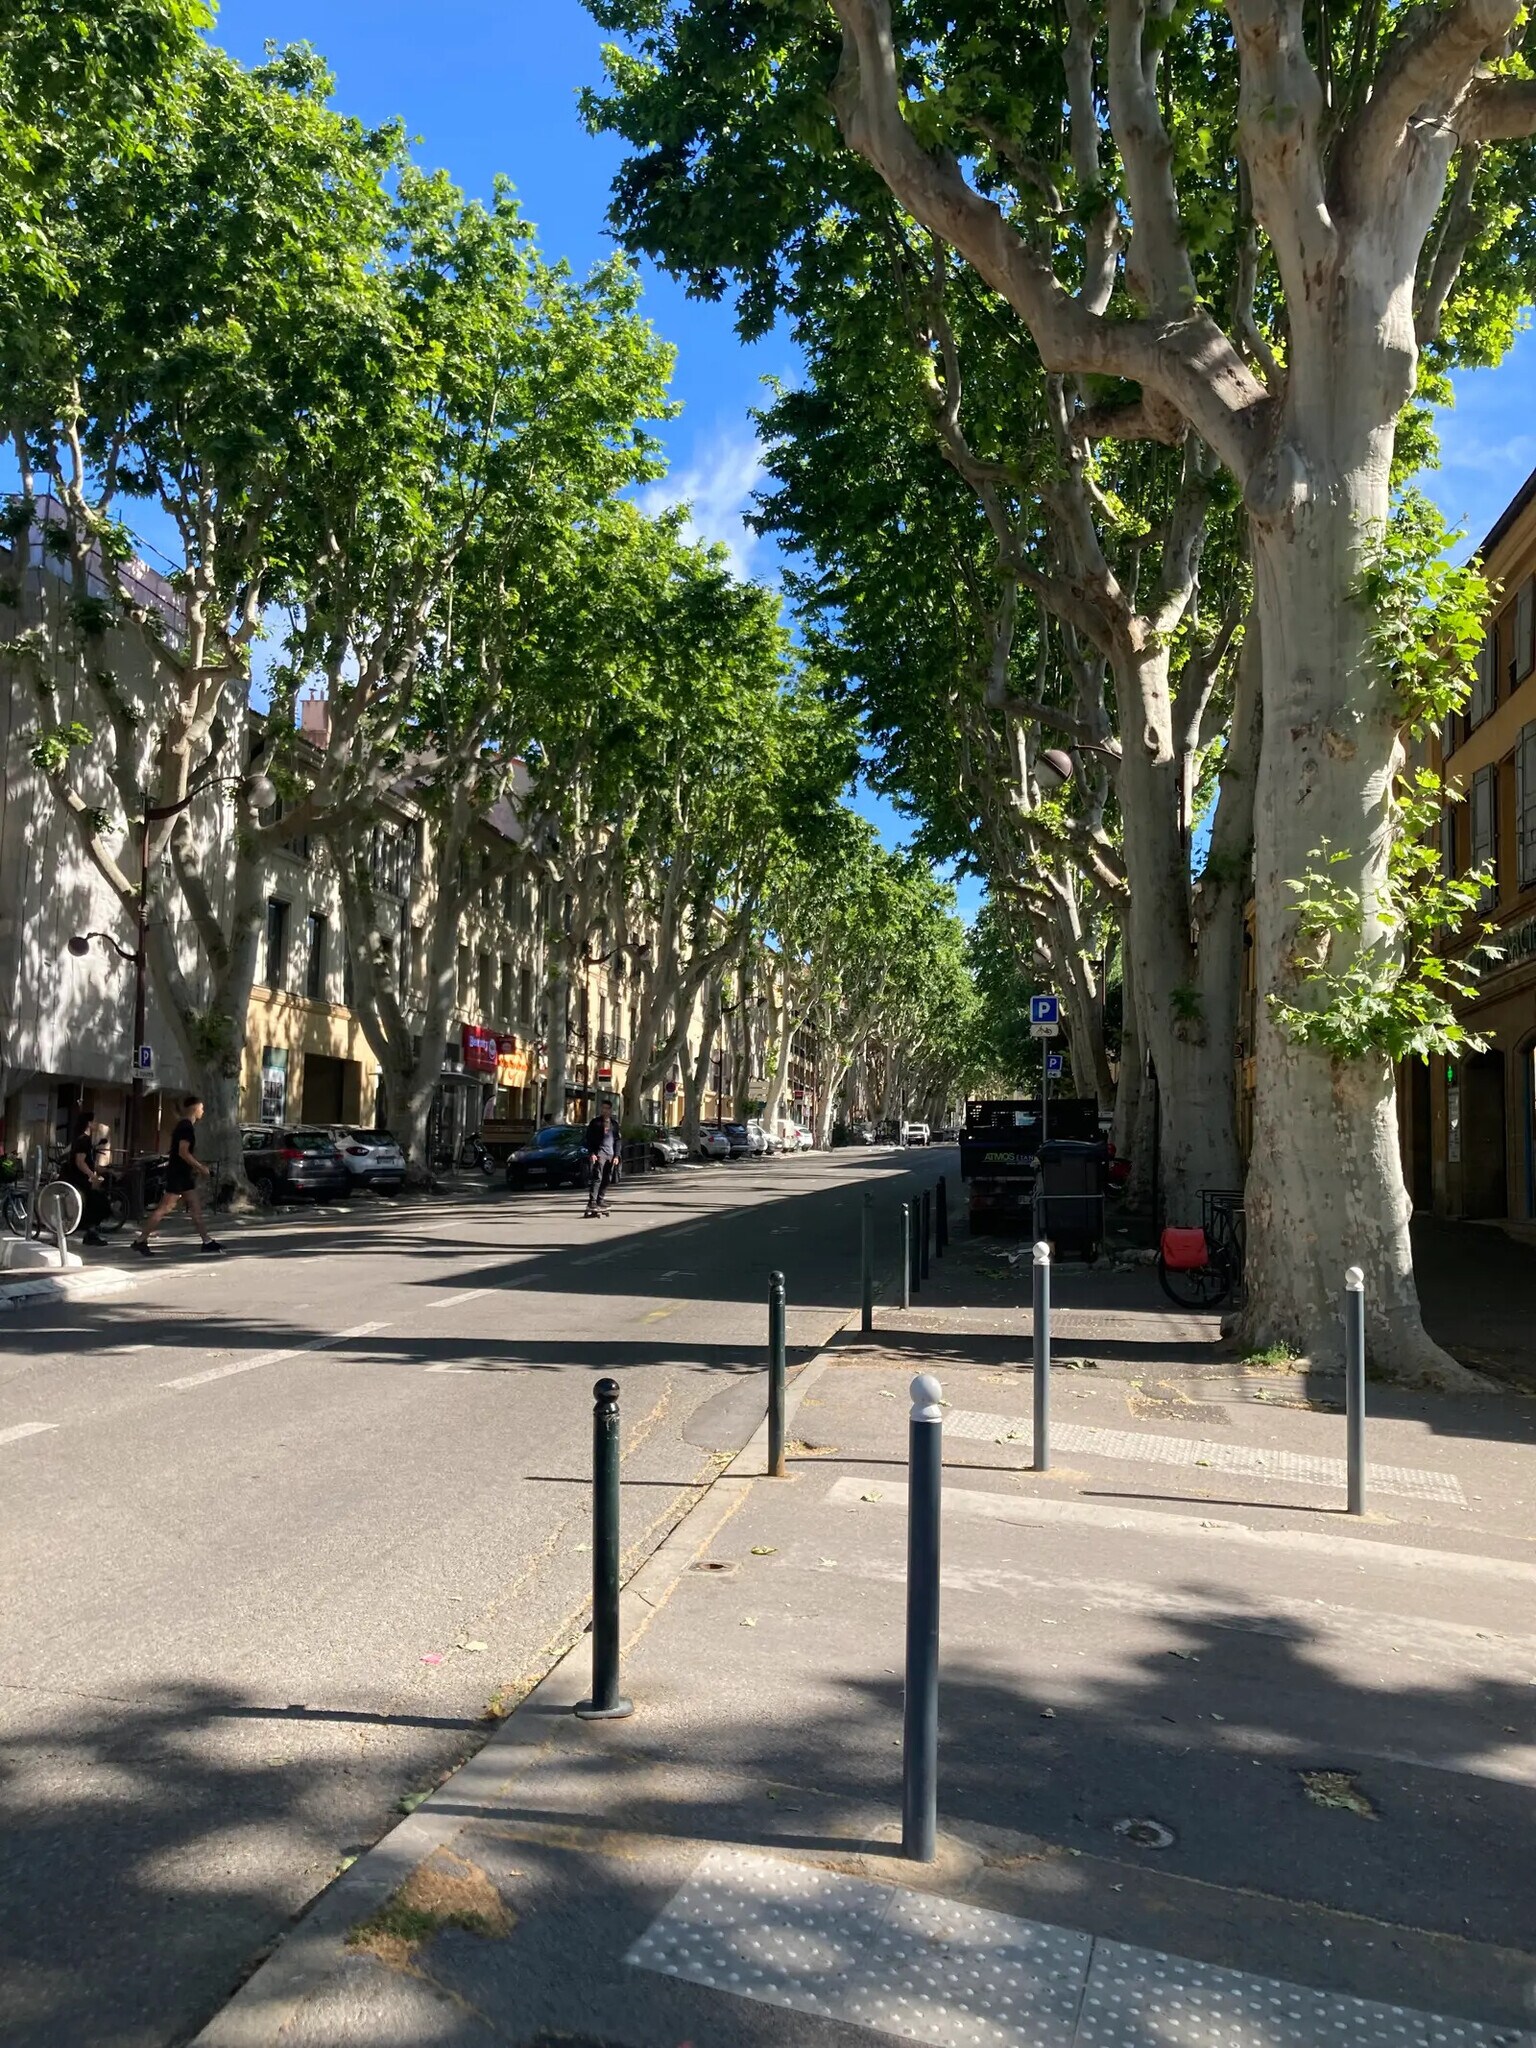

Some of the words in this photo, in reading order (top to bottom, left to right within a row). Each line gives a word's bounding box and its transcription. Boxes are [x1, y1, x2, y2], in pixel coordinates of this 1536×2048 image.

[1038, 1001, 1051, 1018] P
[143, 1050, 149, 1064] P
[1049, 1058, 1057, 1068] P
[984, 1152, 1015, 1161] ATMOS
